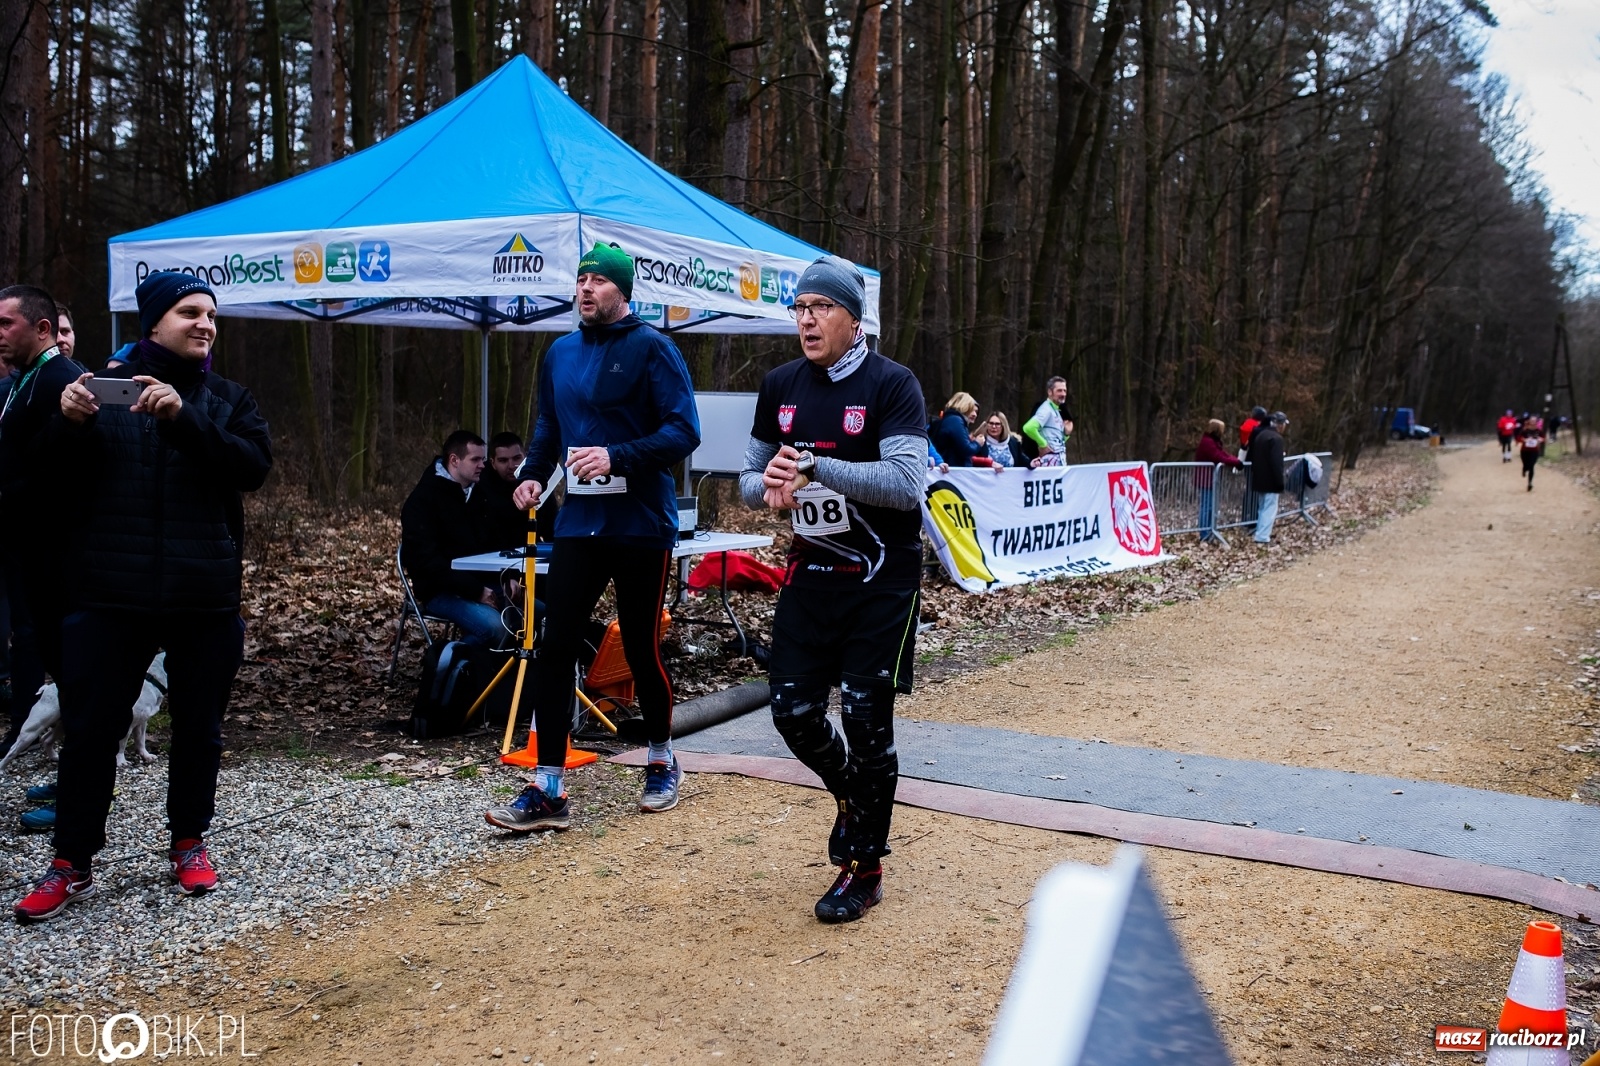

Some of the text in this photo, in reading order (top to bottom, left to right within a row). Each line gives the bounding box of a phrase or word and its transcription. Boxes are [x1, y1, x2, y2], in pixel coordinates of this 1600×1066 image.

[493, 254, 544, 274] MITKO
[511, 275, 542, 283] events
[1023, 478, 1063, 508] BIEG
[991, 514, 1101, 557] TWARDZIELA
